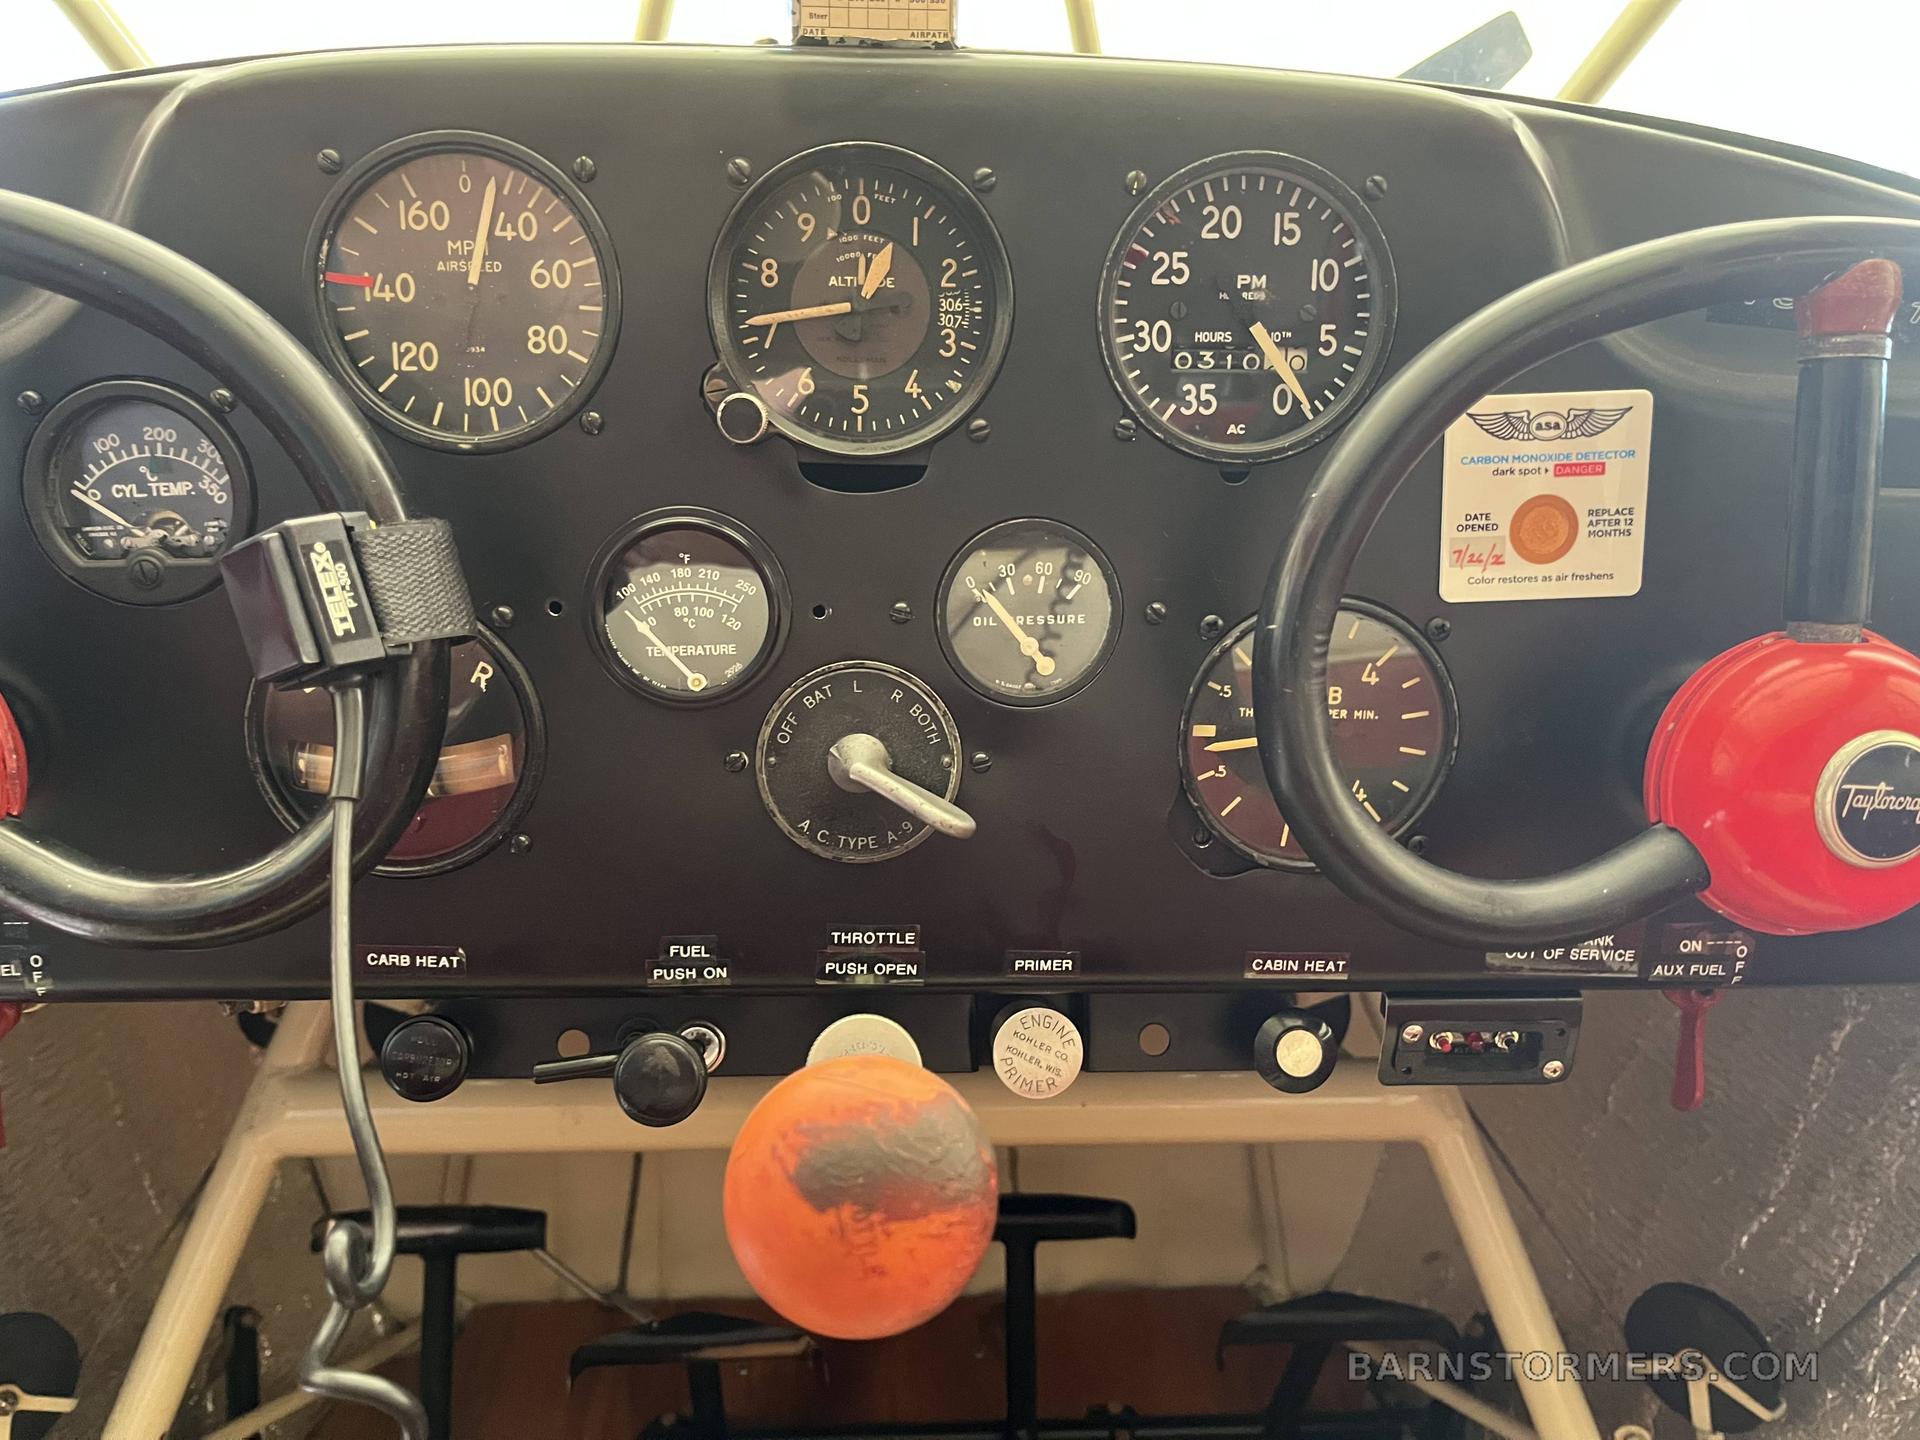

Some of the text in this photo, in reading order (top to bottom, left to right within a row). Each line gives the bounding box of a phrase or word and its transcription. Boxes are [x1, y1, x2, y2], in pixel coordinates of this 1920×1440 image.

[802, 28, 949, 39] DATE AIRPATH
[459, 174, 471, 193] 0
[828, 193, 897, 204] 100 FEET
[400, 199, 450, 231] 160
[852, 195, 871, 225] 0
[494, 211, 538, 242] 40
[797, 213, 816, 243] 9
[912, 216, 919, 246] 1
[1201, 205, 1243, 240] 20
[1273, 212, 1302, 247] 15
[530, 259, 572, 289] 60
[761, 258, 779, 288] 8
[940, 258, 958, 288] 2
[1151, 251, 1191, 286] 25
[1311, 258, 1340, 292] 10
[364, 272, 416, 303] 140
[527, 325, 568, 355] 80
[938, 328, 957, 358] 3
[1133, 320, 1172, 353] 30
[1194, 331, 1233, 343] HOURS
[1318, 324, 1337, 357] 5
[391, 341, 439, 372] 120
[798, 367, 816, 396] 6
[904, 369, 922, 399] 4
[464, 376, 513, 407] 100
[851, 384, 870, 415] 5
[1179, 383, 1218, 416] 35
[1272, 383, 1293, 416] 0
[1226, 424, 1246, 435] AC
[1534, 421, 1561, 431] asa
[93, 433, 121, 454] 100
[143, 427, 178, 443] 200
[1461, 450, 1636, 466] CARBON MONOXIDE DETECTOR
[1492, 465, 1603, 479] dark spot DANGER
[87, 489, 102, 501] 0
[111, 481, 196, 498] CYL TEMP.
[199, 475, 228, 505] 350
[1465, 513, 1491, 522] DATE
[1588, 507, 1634, 517] REPLACE
[1456, 523, 1499, 532] OPENED
[1587, 518, 1634, 528] AFTER 12
[1588, 529, 1632, 538] MONTHS
[670, 568, 692, 578] 180
[698, 568, 720, 581] 210
[998, 563, 1016, 578] 30
[1035, 561, 1053, 575] 60
[640, 572, 661, 587] 140
[965, 576, 976, 589] 0
[1073, 569, 1092, 585] 90
[1468, 576, 1494, 586] Color
[1498, 575, 1538, 584] restores
[1555, 573, 1569, 582] air
[1571, 571, 1614, 581] freshens
[310, 550, 356, 637] TELEX
[616, 583, 637, 600] 100
[735, 579, 757, 596] 250
[674, 606, 689, 617] 80
[693, 606, 714, 619] 100
[647, 616, 657, 627] 0
[721, 614, 742, 631] 120
[973, 614, 1086, 627] OIL RESSURE
[470, 661, 494, 693] R
[1361, 662, 1380, 686] 4
[853, 680, 863, 693] L
[803, 684, 833, 709] BAT
[890, 688, 904, 703] R
[1353, 709, 1379, 720] MIN.
[777, 712, 799, 745] OFF
[909, 703, 942, 745] BOTH
[1841, 782, 1920, 824] Taylorcra
[837, 835, 878, 850] TYPE
[887, 821, 914, 844] A-9
[831, 932, 916, 945] THROTTLE
[1680, 940, 1702, 952] ON
[670, 945, 710, 958] FUEL
[1543, 948, 1566, 960] OF
[1570, 948, 1635, 962] SERVICE
[367, 953, 460, 968] CARB HEAT
[825, 962, 918, 976] PUSH OPEN
[1014, 959, 1073, 971] PRIMER
[1251, 959, 1346, 973] CABIN HEAT
[653, 967, 727, 980] PUSH ON
[1653, 964, 1726, 976] AUX FUEL
[1020, 1013, 1076, 1049] ENGINE
[1013, 1030, 1069, 1062] KOHLER CO.
[1000, 1057, 1058, 1093] PRIMER
